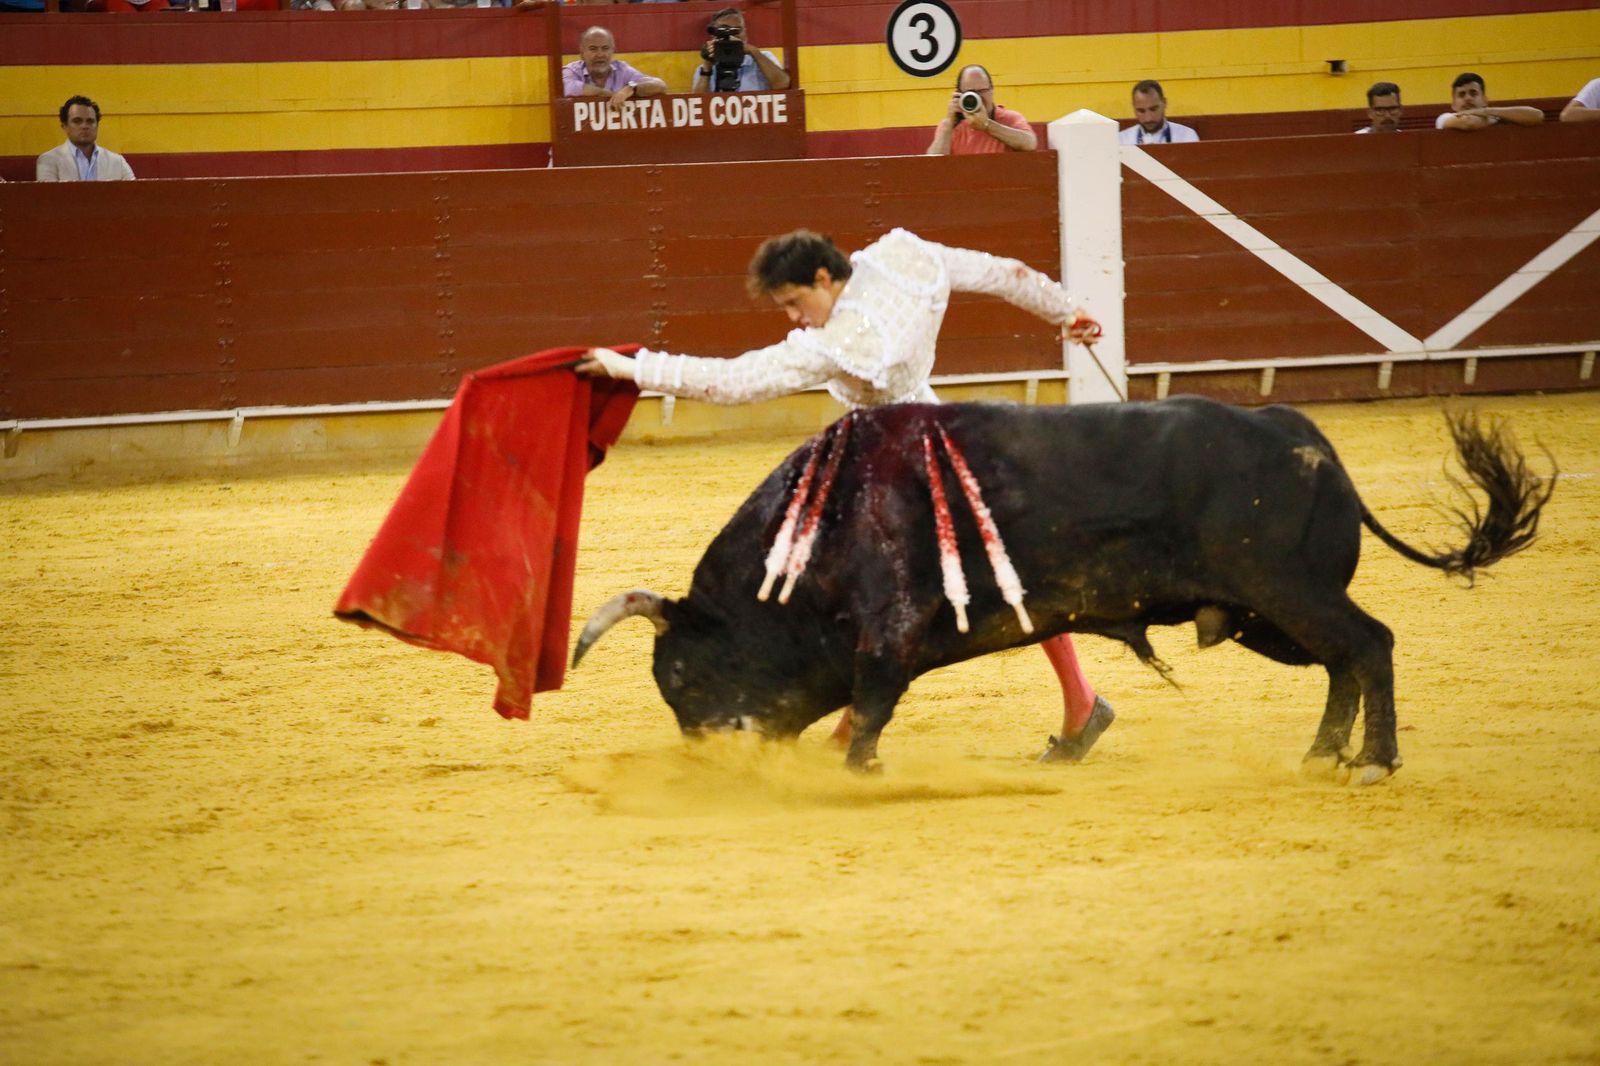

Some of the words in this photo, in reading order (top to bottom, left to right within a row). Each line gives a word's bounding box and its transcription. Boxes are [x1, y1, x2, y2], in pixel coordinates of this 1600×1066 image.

[909, 12, 939, 63] 3
[574, 99, 667, 131] PUERTA
[672, 97, 704, 128] DE
[709, 94, 788, 126] CORTE
